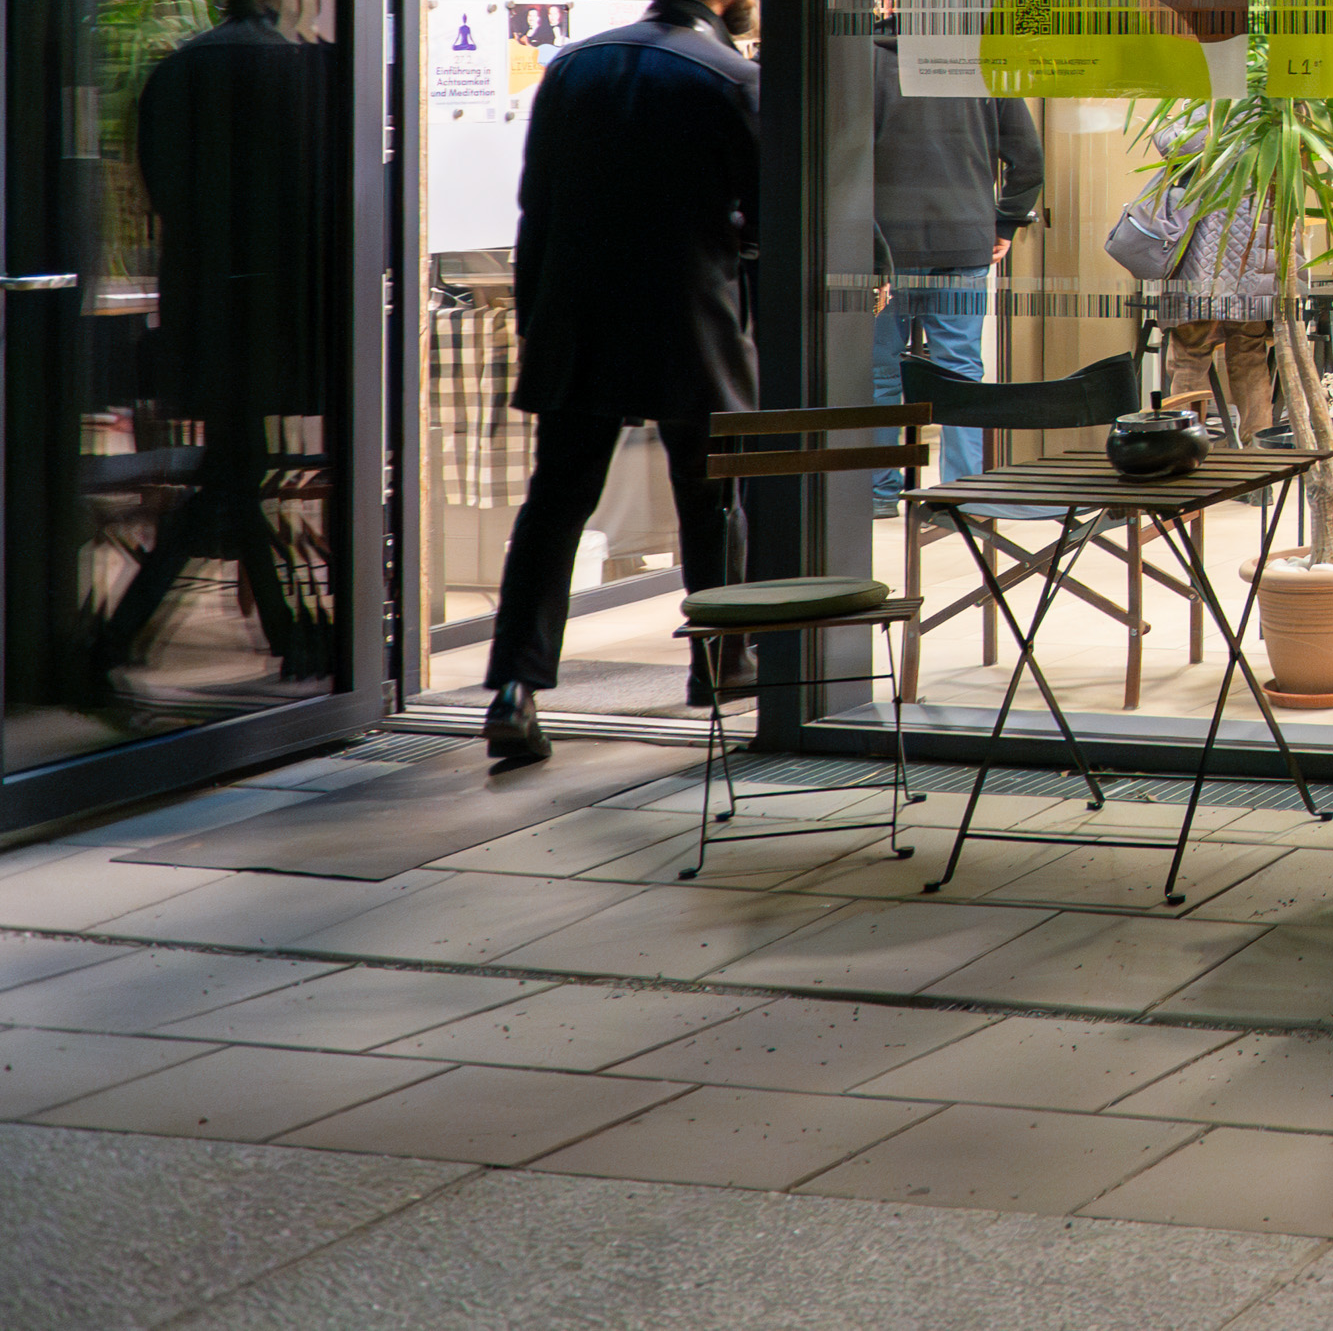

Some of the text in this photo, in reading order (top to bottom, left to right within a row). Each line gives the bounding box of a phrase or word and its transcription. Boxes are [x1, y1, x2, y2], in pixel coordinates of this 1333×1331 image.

[436, 66, 481, 77] Einführung
[436, 77, 490, 86] Achtsamkeit
[430, 87, 496, 97] und Meditation
